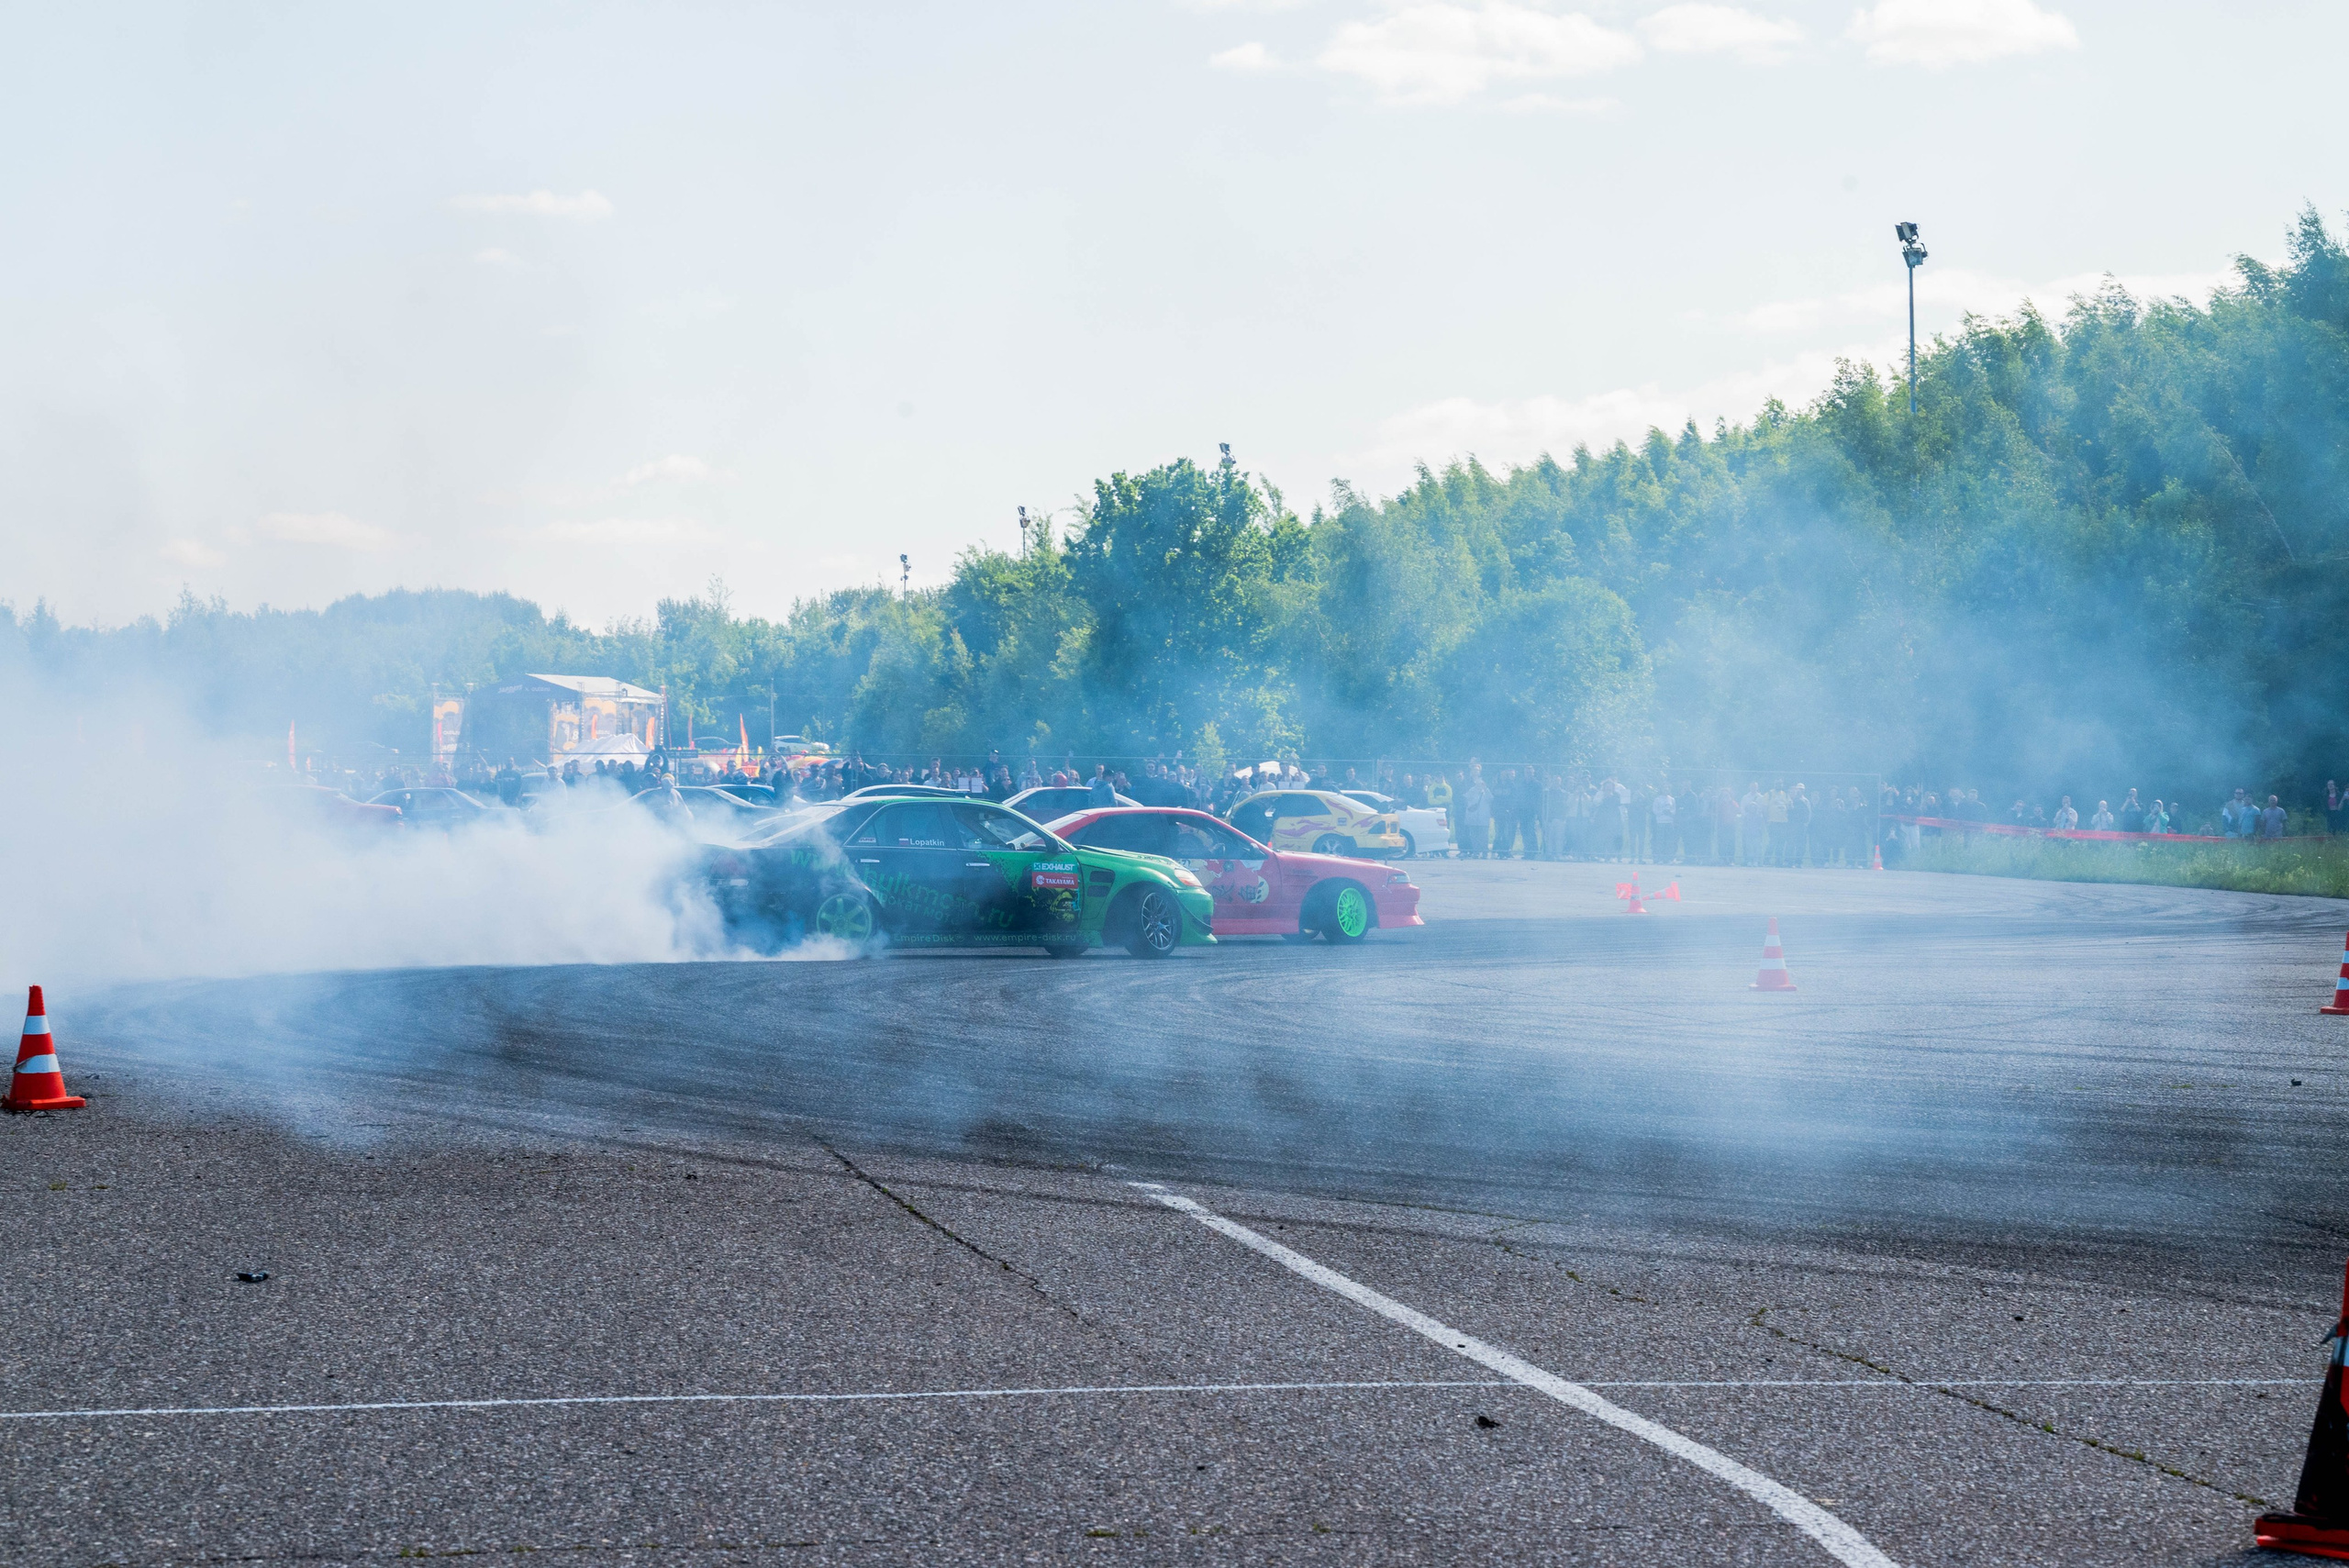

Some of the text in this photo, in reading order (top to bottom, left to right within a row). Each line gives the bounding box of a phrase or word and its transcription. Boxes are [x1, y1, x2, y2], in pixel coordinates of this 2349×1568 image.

[910, 838, 945, 847] Lopatkin
[1041, 862, 1075, 872] EXHAUST
[973, 932, 1076, 943] www.empire-disk.ru
